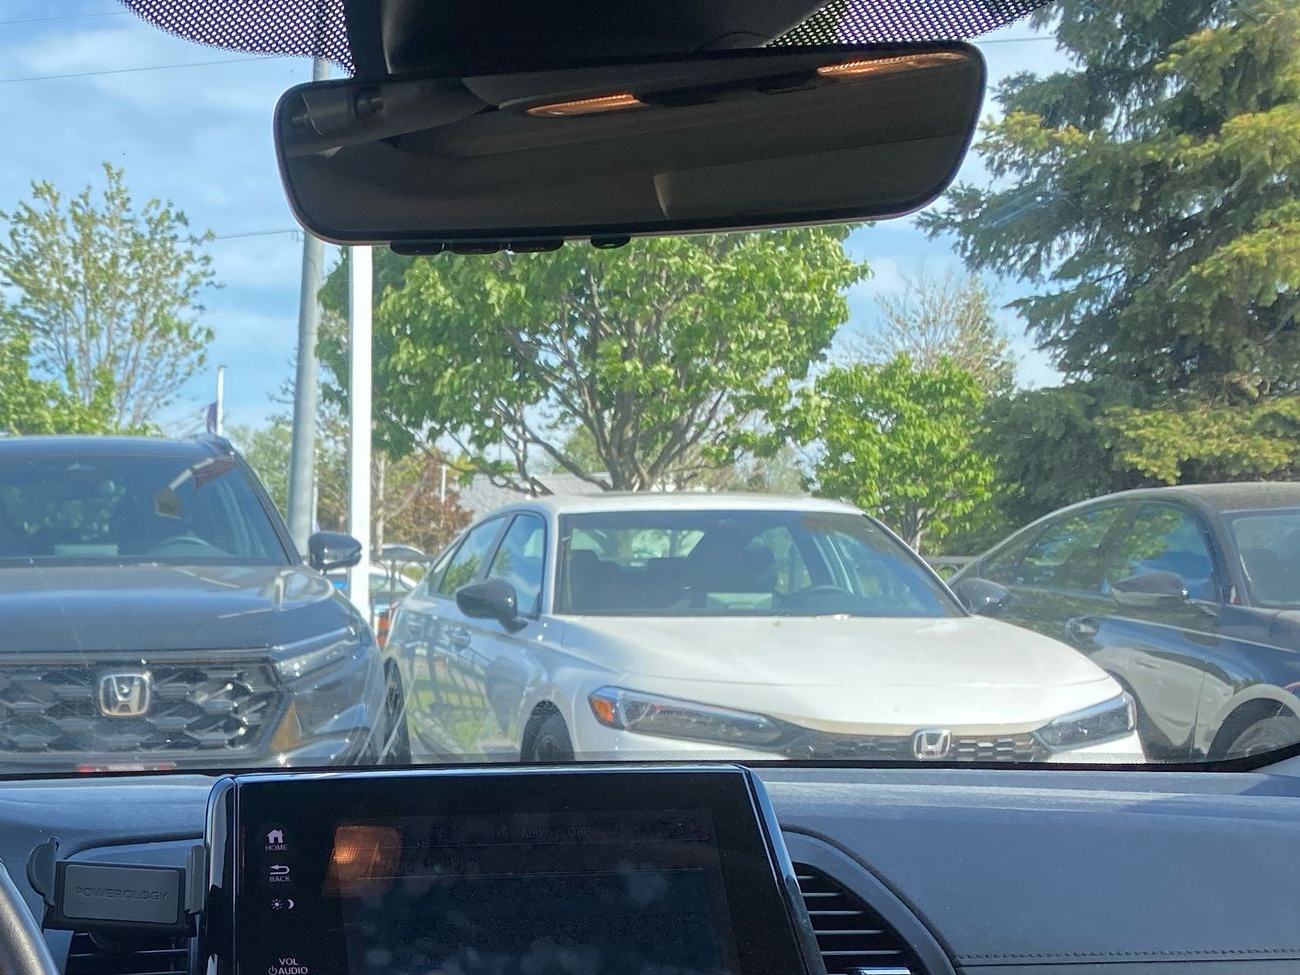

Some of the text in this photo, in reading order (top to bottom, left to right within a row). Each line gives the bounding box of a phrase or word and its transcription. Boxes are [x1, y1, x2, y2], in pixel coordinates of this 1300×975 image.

[269, 875, 291, 883] BACK
[74, 886, 170, 902] POWEROLOGY
[279, 958, 299, 966] VOL
[278, 966, 309, 975] AUDIO
